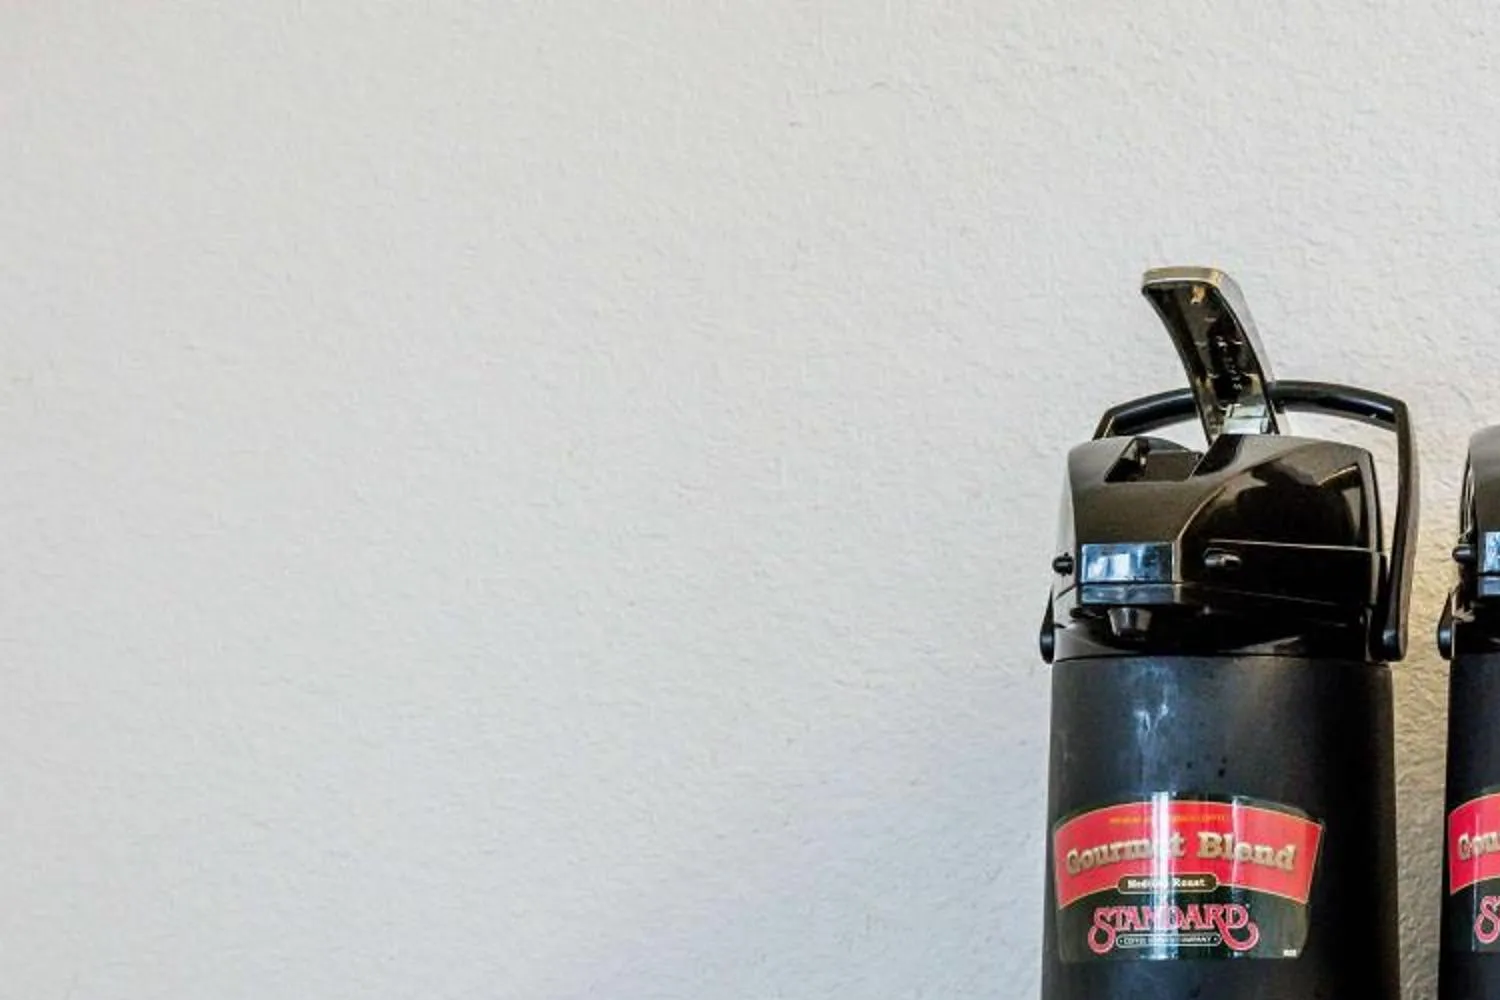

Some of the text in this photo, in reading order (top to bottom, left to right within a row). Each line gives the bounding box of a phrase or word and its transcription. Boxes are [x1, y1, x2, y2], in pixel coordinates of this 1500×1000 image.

[1064, 831, 1297, 876] Gourmt Blend
[1087, 903, 1260, 955] STANDARD
